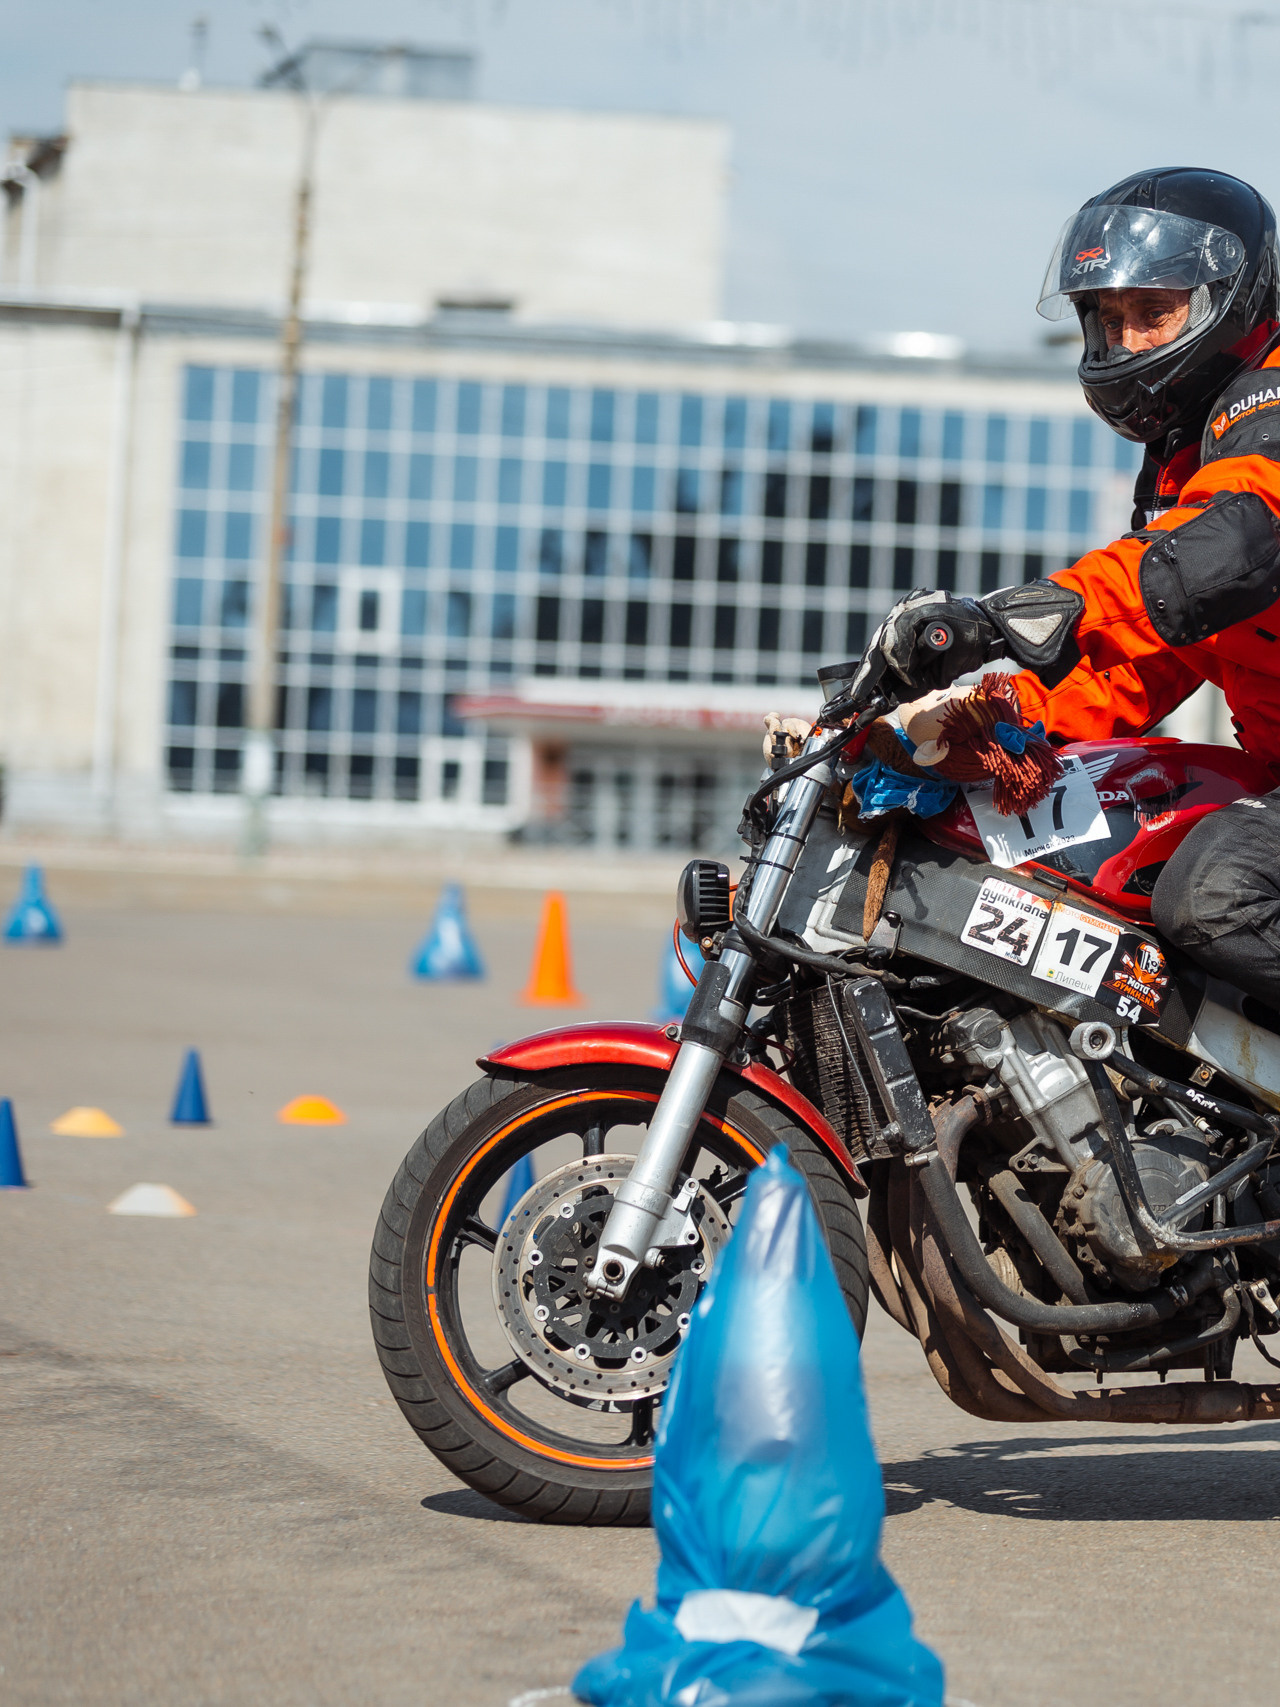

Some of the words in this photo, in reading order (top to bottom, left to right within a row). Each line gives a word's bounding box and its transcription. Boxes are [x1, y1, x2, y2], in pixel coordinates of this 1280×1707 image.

[1230, 406, 1256, 425] MOTOR
[968, 902, 1029, 956] 24
[1055, 928, 1112, 974] 17
[1055, 971, 1093, 992] Липецк
[1127, 976, 1151, 995] MOTO
[1116, 995, 1142, 1024] 54
